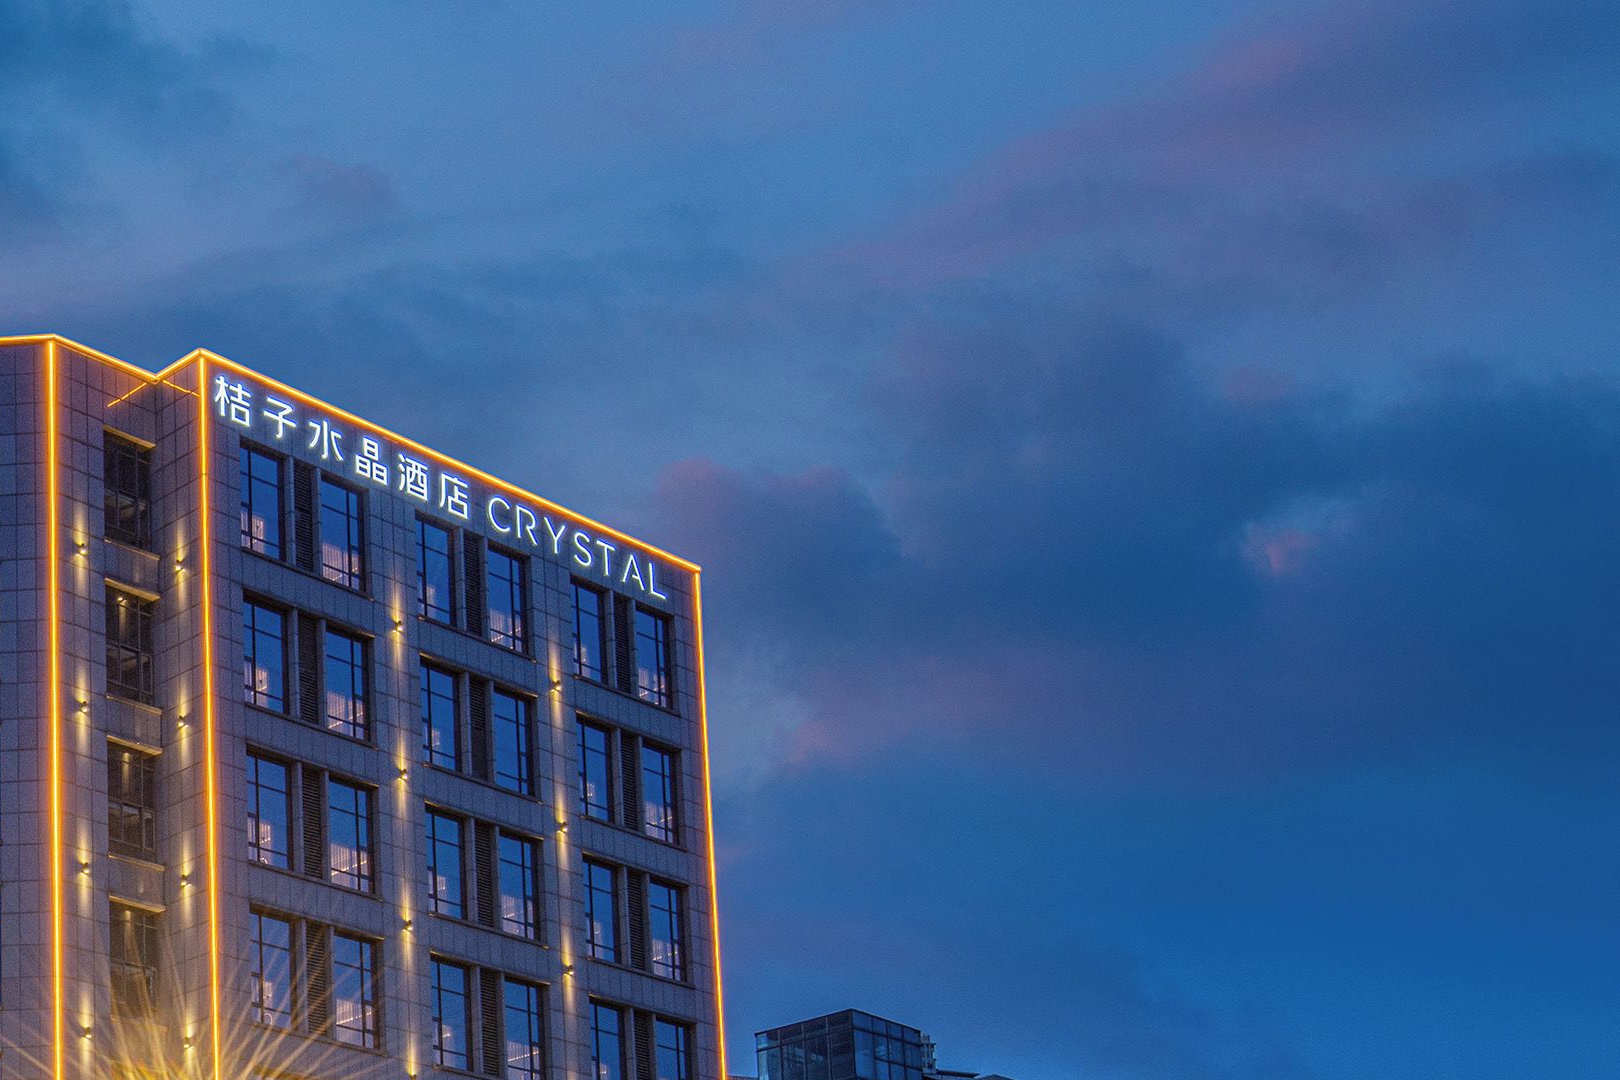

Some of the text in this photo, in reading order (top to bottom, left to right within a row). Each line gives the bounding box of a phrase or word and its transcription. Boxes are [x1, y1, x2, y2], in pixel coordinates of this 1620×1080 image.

[214, 375, 668, 601] 桔子水晶酒店 CRYSTAL
